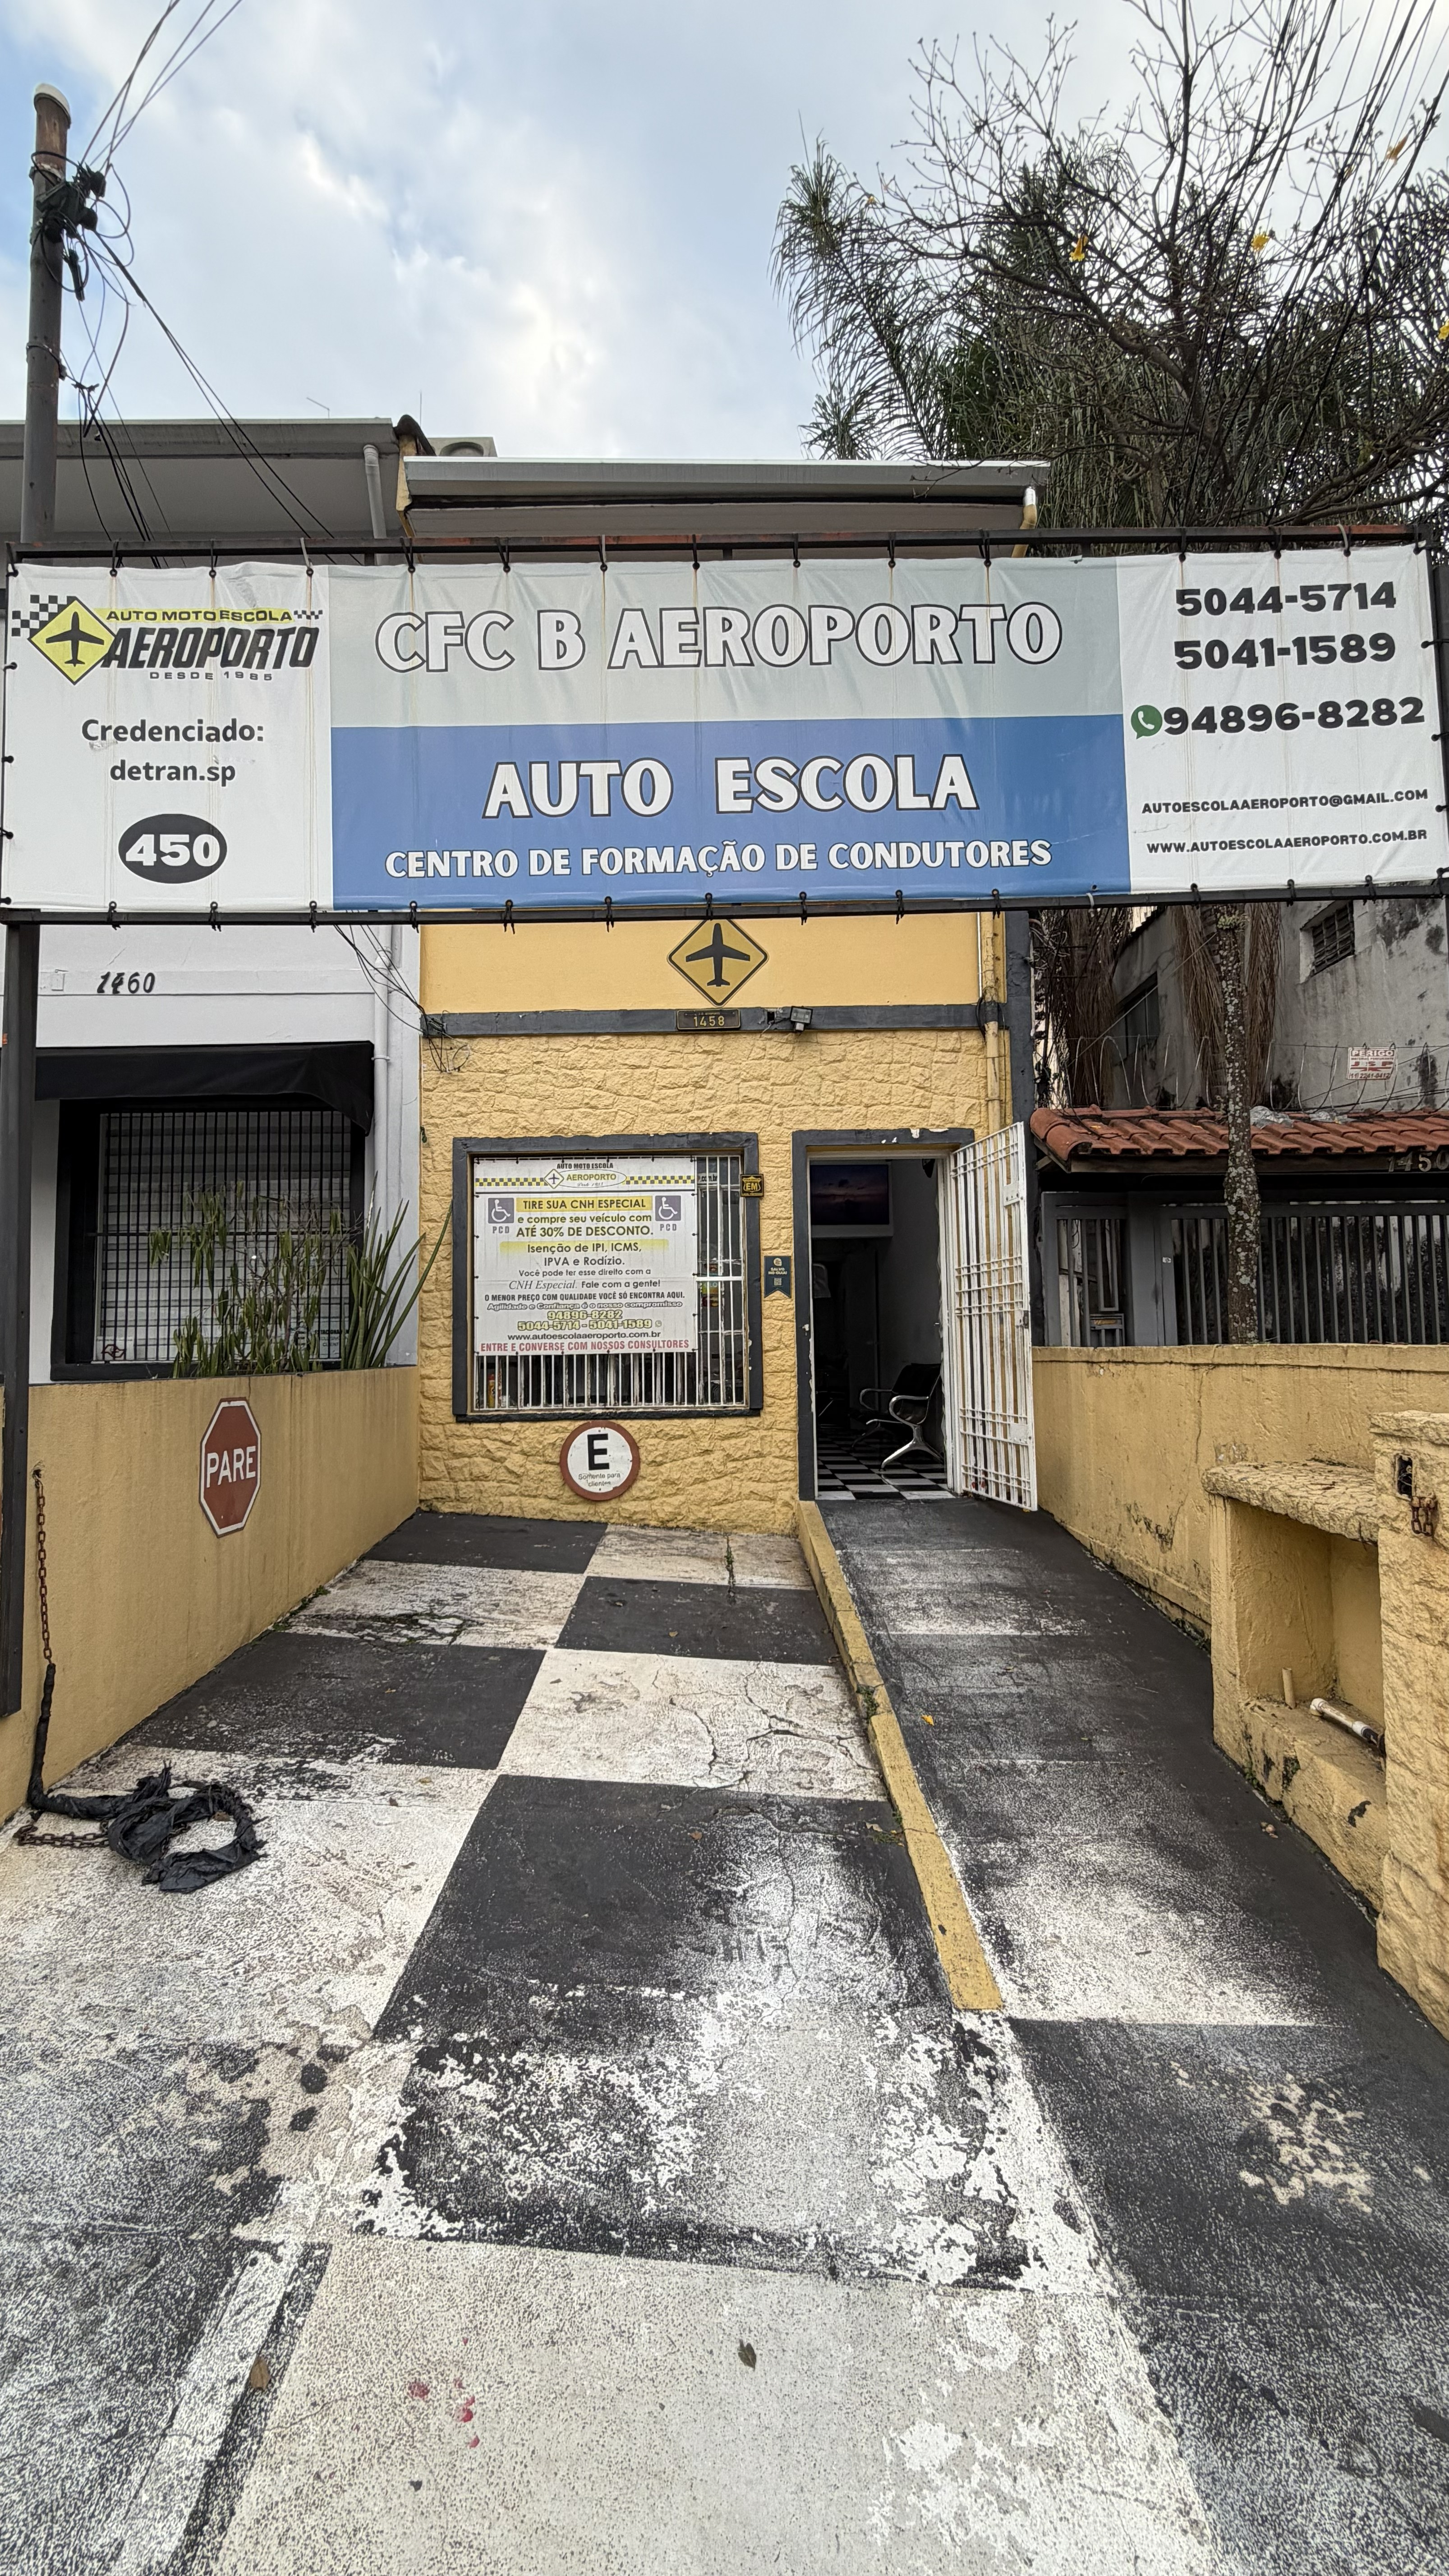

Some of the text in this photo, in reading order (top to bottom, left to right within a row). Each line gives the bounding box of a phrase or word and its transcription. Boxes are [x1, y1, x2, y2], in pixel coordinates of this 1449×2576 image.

[1175, 581, 1396, 616] 5044-5714
[106, 610, 293, 622] AUTO MOTO ESCOLA
[375, 602, 1063, 673] CFC B AEROPORTO
[100, 626, 319, 669] AEROPORTO
[1174, 633, 1395, 670] 5041-1589
[149, 671, 214, 680] DESDE
[1163, 696, 1425, 735] 94896-8282
[82, 718, 264, 743] Credenciado:
[110, 759, 236, 787] detran.sp
[482, 753, 980, 819] AUTO ESCOLA
[1141, 789, 1428, 814] AUTOESCOLAAEROPORTO@GMAIL.COM
[1147, 829, 1427, 854] WWW.AUTOESCOLAAEROPORTO.COM.BR
[125, 833, 220, 867] 450
[385, 840, 1053, 879] CENTRO DE FORMAÇÃO DE CONDUTORES
[694, 1016, 725, 1026] 1458
[523, 1199, 645, 1209] TIRE SUA CNH ESPECIAL
[527, 1216, 566, 1225] compre
[589, 1213, 626, 1222] veículo
[516, 1224, 653, 1237] ATÉ 30% DE DESCONTO.
[528, 1242, 642, 1255] Isenção de IPI, ICMS,
[544, 1257, 570, 1266] IPVA
[584, 1256, 625, 1265] Rodízio.
[509, 1280, 533, 1289] CNH
[535, 1280, 577, 1291] Especial.
[633, 1279, 660, 1288] gente!
[518, 1294, 540, 1302] PREÇO
[599, 1291, 616, 1299] VOCÊ
[619, 1291, 627, 1299] SÓ
[487, 1303, 528, 1311] Agilidade
[537, 1302, 580, 1311] Confiança
[625, 1301, 683, 1309] compromisso
[547, 1310, 622, 1320] 94896-8282
[517, 1320, 580, 1330] 5044-5714
[589, 1319, 652, 1329] 5041-1589
[508, 1331, 661, 1340] www.autoescolaaeroporto.com.br
[481, 1343, 508, 1351] ENTRE
[519, 1343, 565, 1351] CONVERSE
[568, 1342, 587, 1350] COM
[591, 1341, 625, 1350] NOSSOS
[628, 1340, 689, 1349] CONSULTORES
[587, 1433, 609, 1470] E
[207, 1446, 256, 1488] PARE
